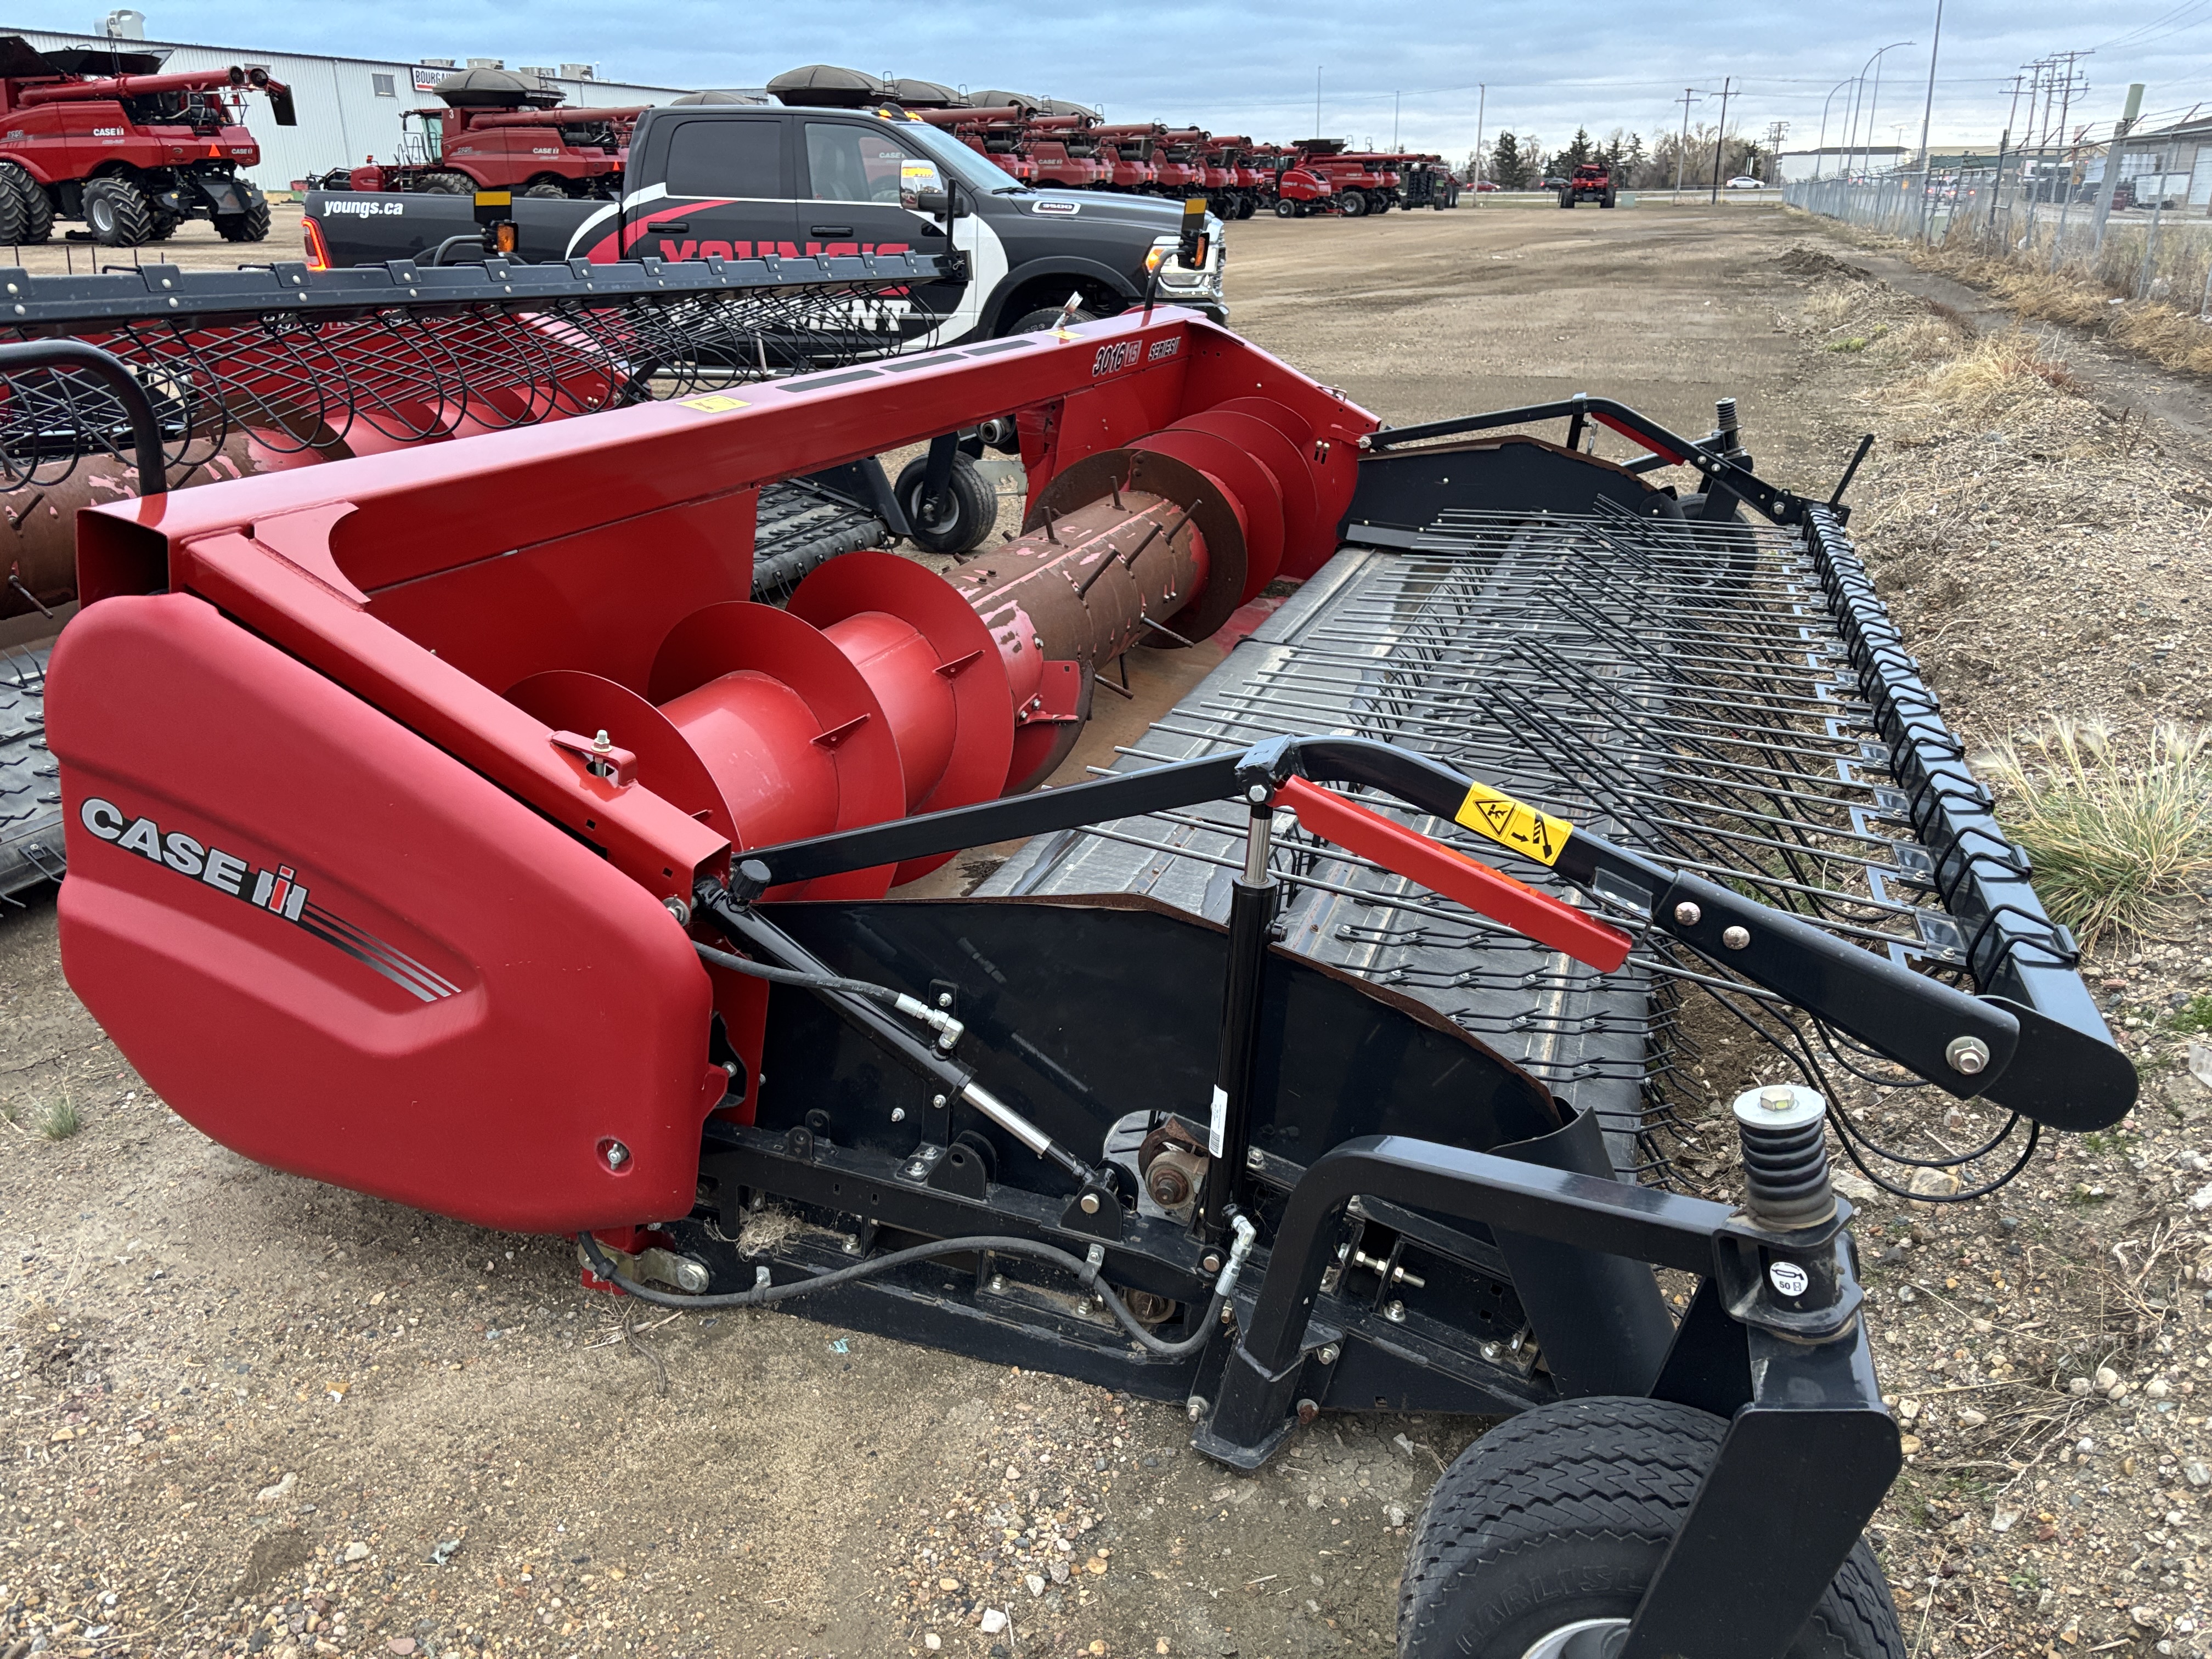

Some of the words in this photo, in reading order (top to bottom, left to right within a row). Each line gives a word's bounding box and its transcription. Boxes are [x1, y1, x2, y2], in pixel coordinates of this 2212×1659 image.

[415, 70, 453, 84] BOURGA
[449, 109, 454, 119] 3
[323, 201, 404, 218] youngs.ca
[1092, 342, 1126, 377] 3016
[81, 797, 247, 895] CASE
[1779, 1280, 1791, 1290] 50
